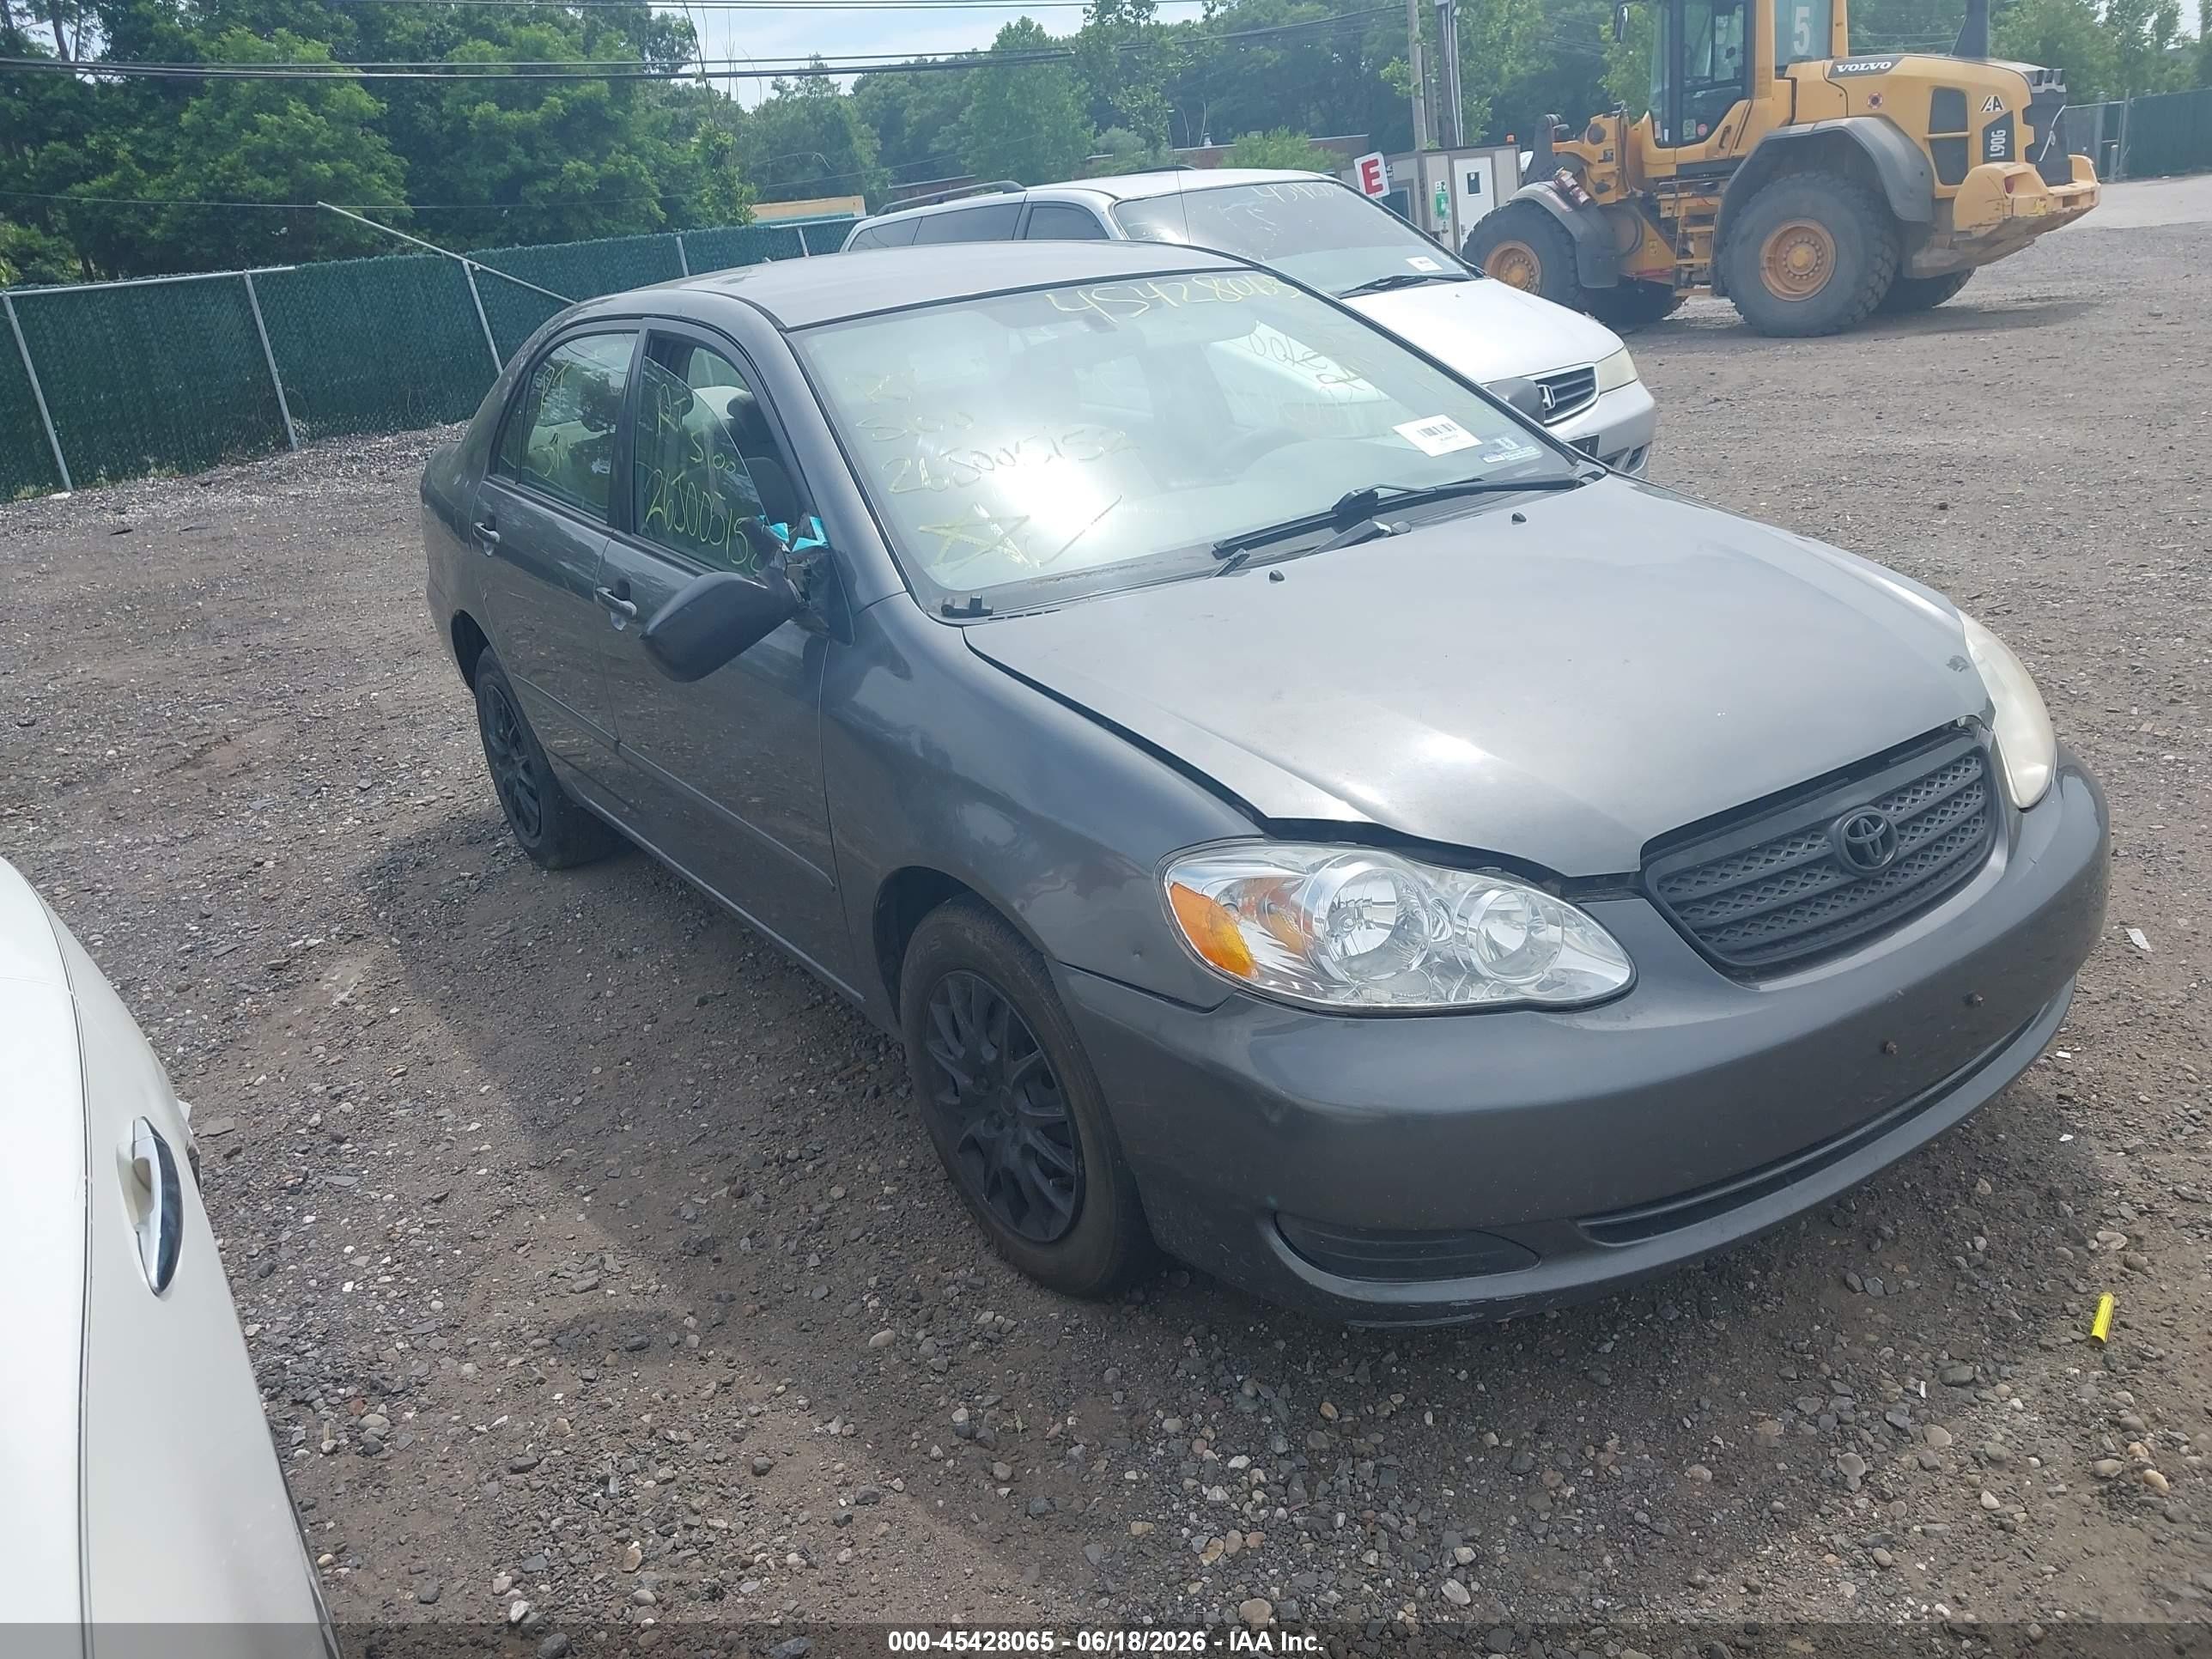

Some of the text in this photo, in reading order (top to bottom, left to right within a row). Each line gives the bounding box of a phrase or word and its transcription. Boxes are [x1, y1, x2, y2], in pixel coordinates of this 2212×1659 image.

[1793, 6, 1811, 56] 5
[1835, 60, 1893, 73] VOLVO
[1989, 129, 2007, 158] L90G
[1360, 158, 1384, 196] E
